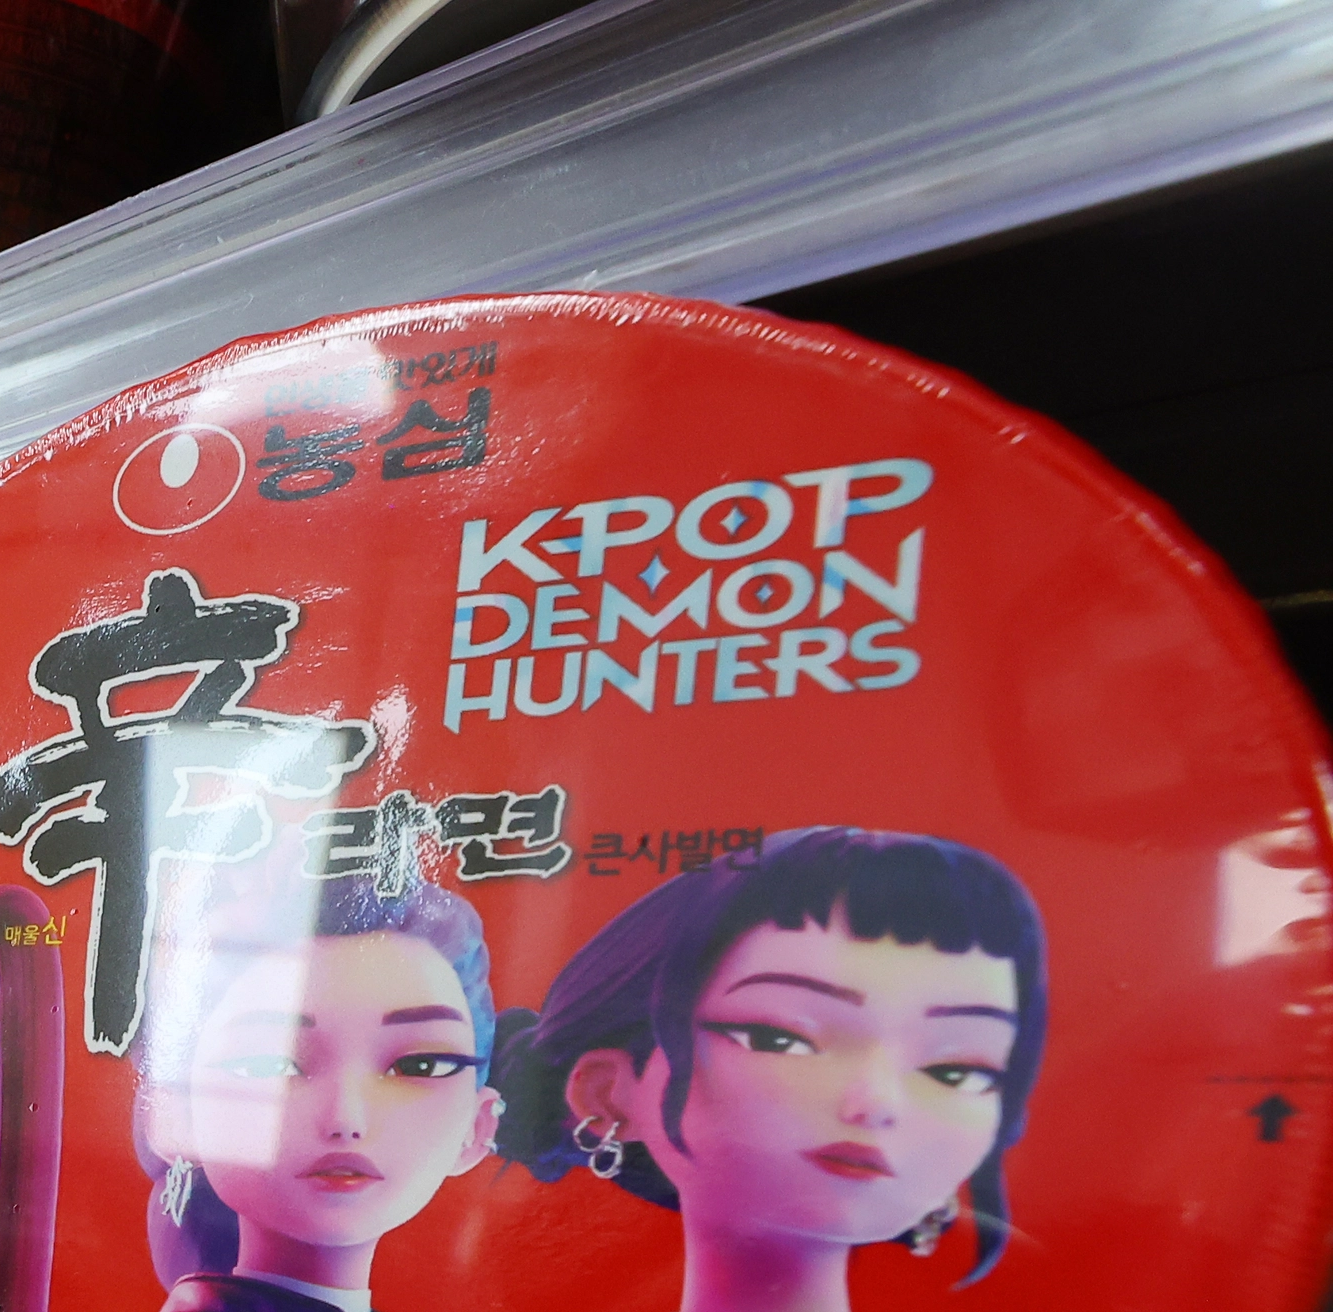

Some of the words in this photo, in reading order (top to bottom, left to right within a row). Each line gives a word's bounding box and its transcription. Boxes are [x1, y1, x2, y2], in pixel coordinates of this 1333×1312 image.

[379, 341, 498, 391] 맛있게
[256, 386, 494, 501] 농심
[450, 526, 925, 660] DEMON
[443, 619, 921, 735] HUNTERS
[301, 784, 573, 900] 라면
[584, 826, 765, 876] 큰사발면
